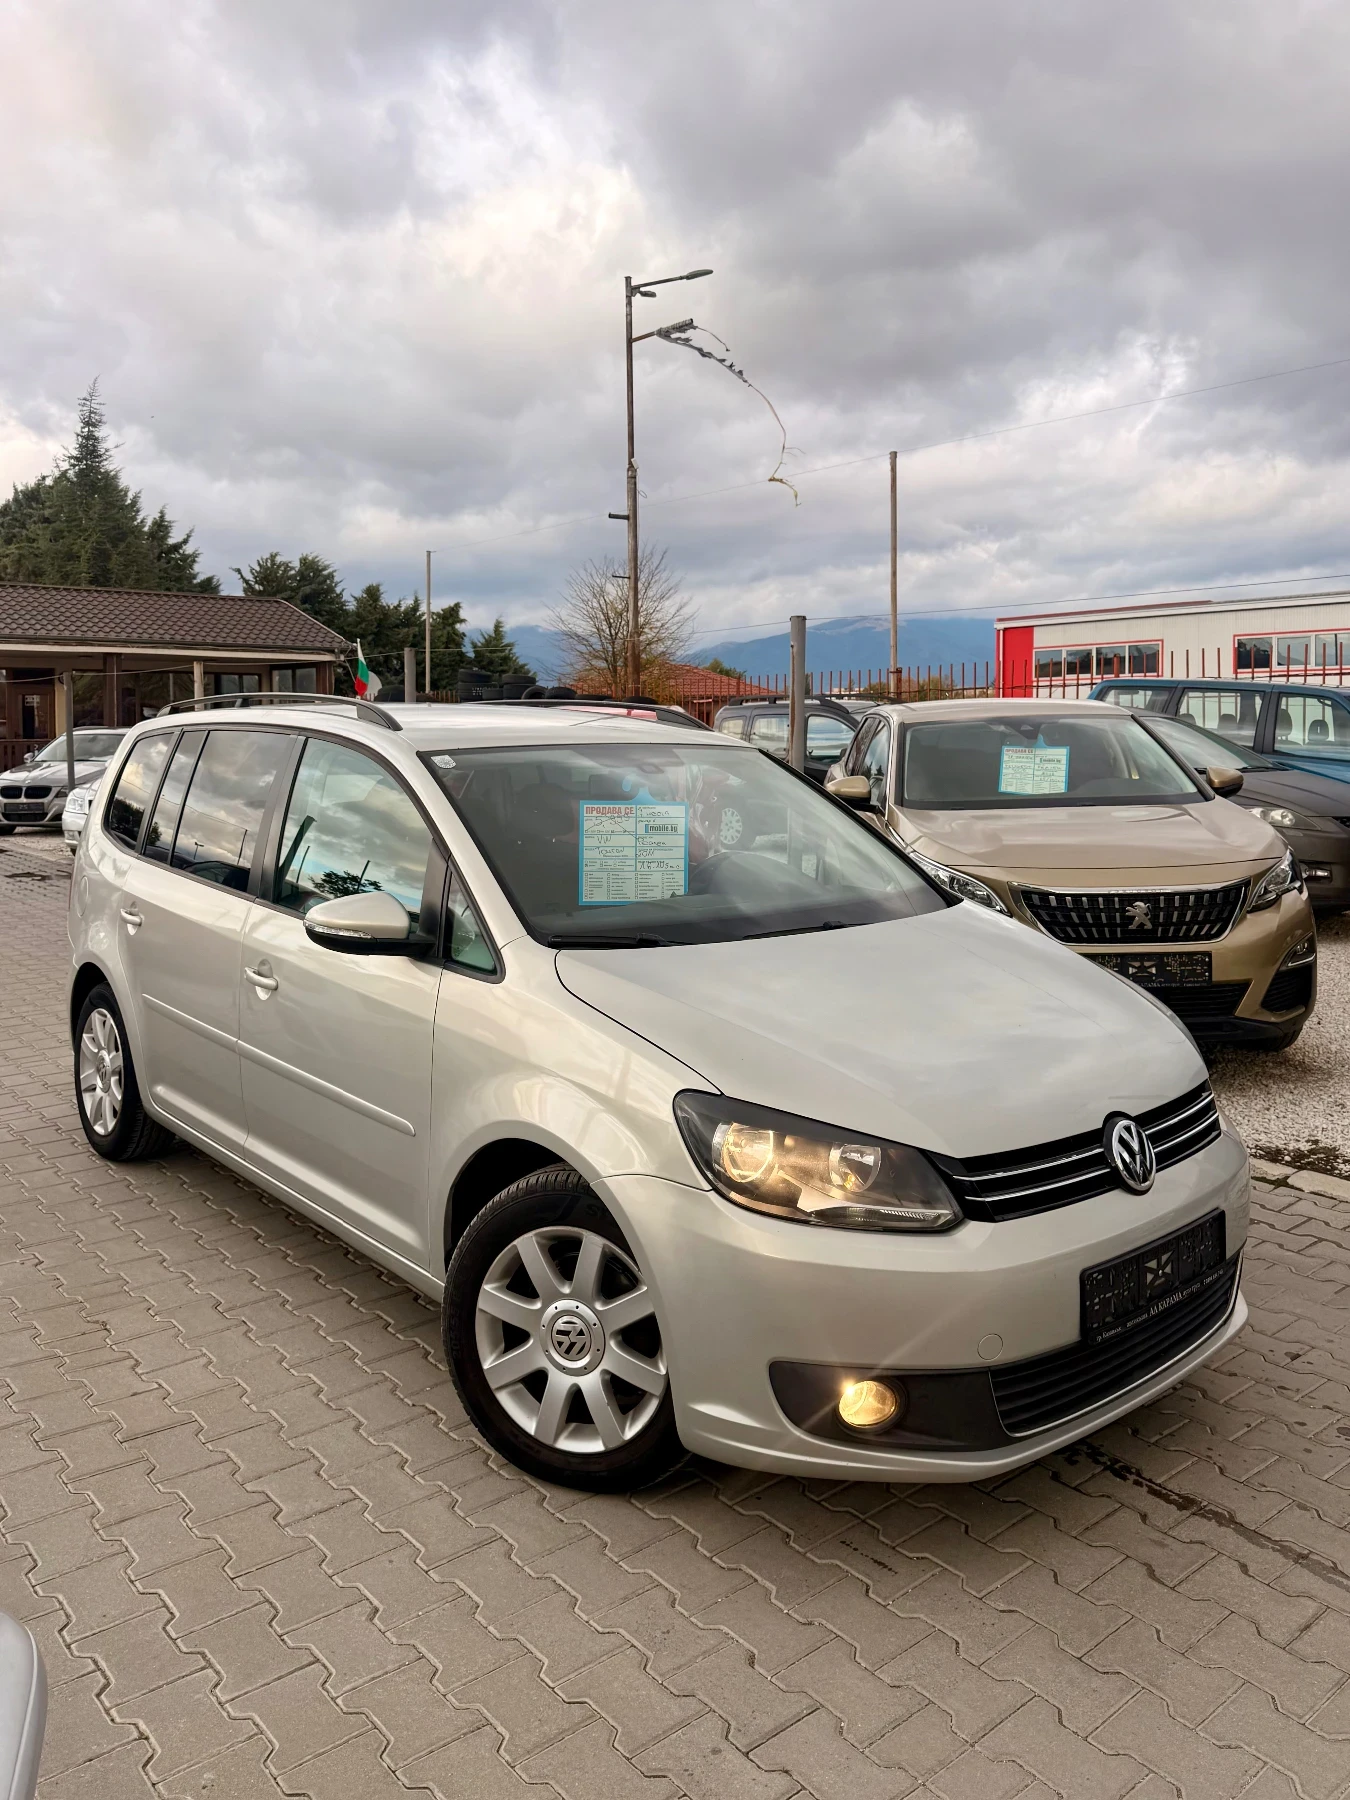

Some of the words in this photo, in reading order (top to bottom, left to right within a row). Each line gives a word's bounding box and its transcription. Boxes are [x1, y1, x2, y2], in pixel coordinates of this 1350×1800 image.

[585, 806, 623, 815] ПРОДАВА
[624, 806, 635, 815] СЕ
[649, 825, 678, 833] mobile.bg
